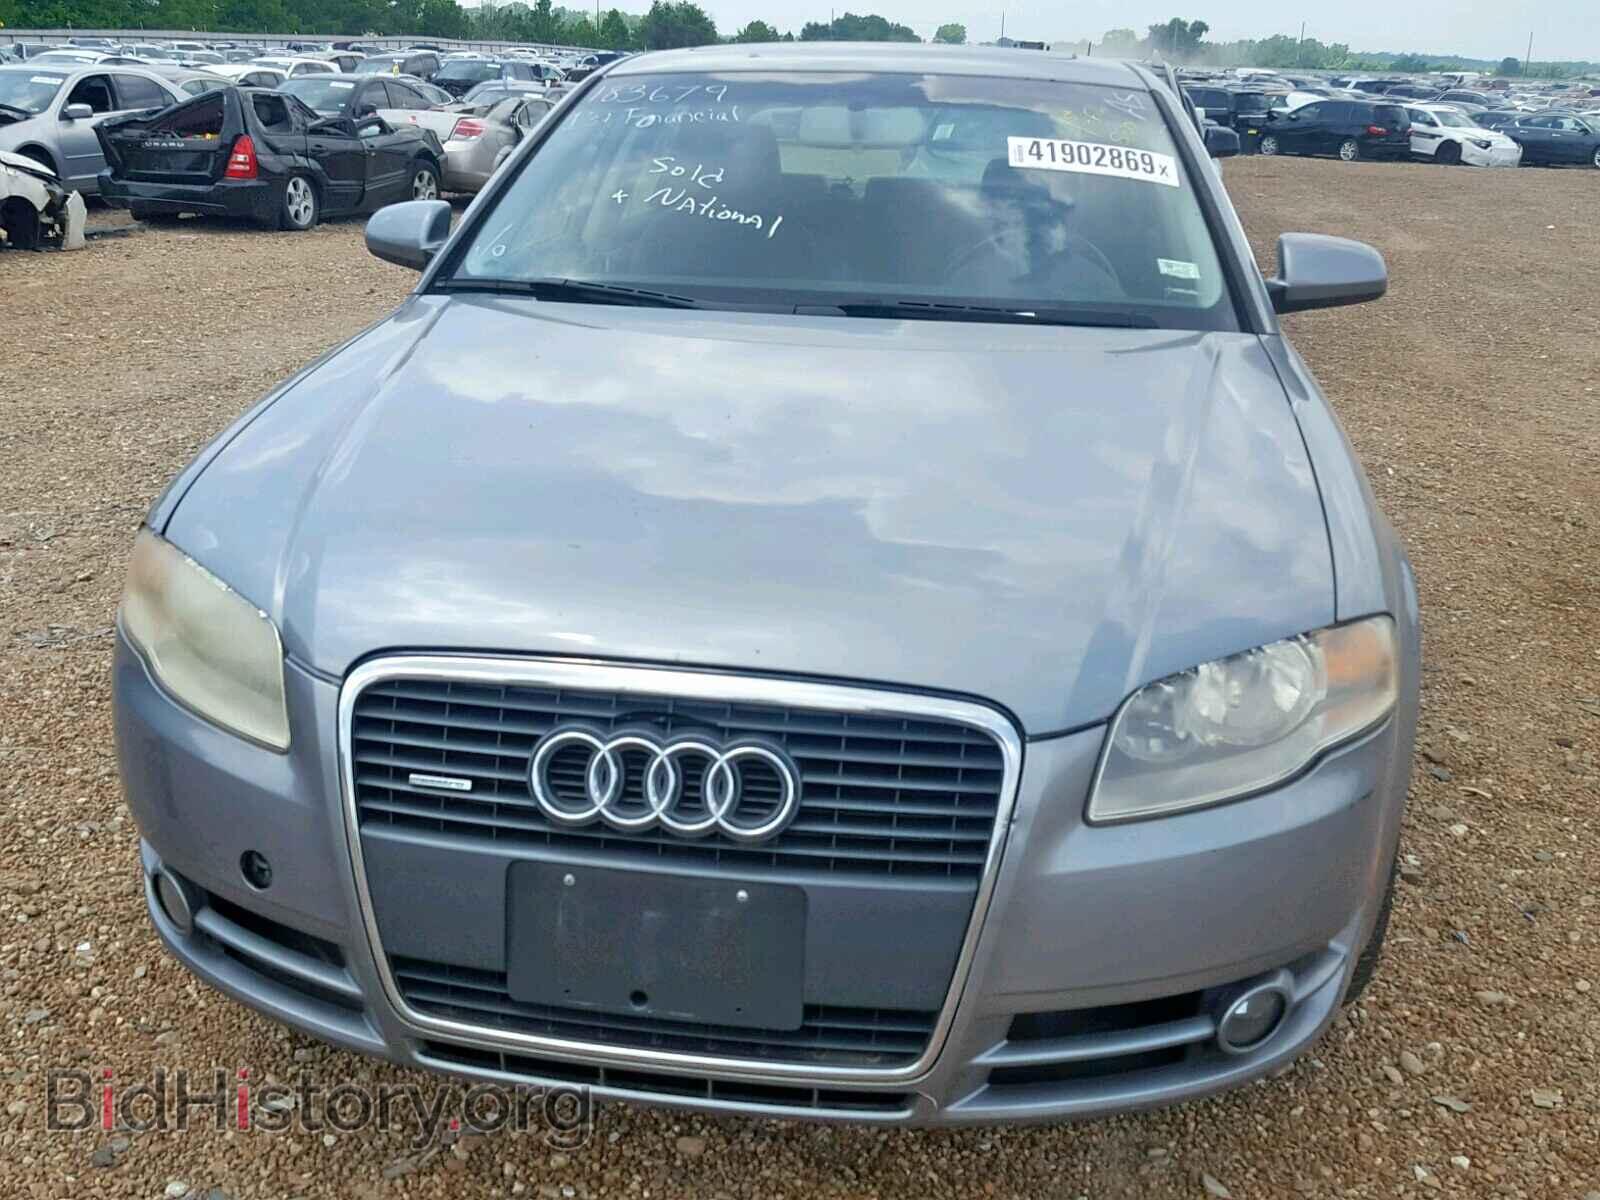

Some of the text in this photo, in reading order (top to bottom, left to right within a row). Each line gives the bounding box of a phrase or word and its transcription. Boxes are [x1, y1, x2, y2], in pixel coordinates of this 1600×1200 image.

[141, 140, 185, 148] UBARU
[1028, 140, 1156, 175] 41902869
[649, 156, 724, 189] Sold
